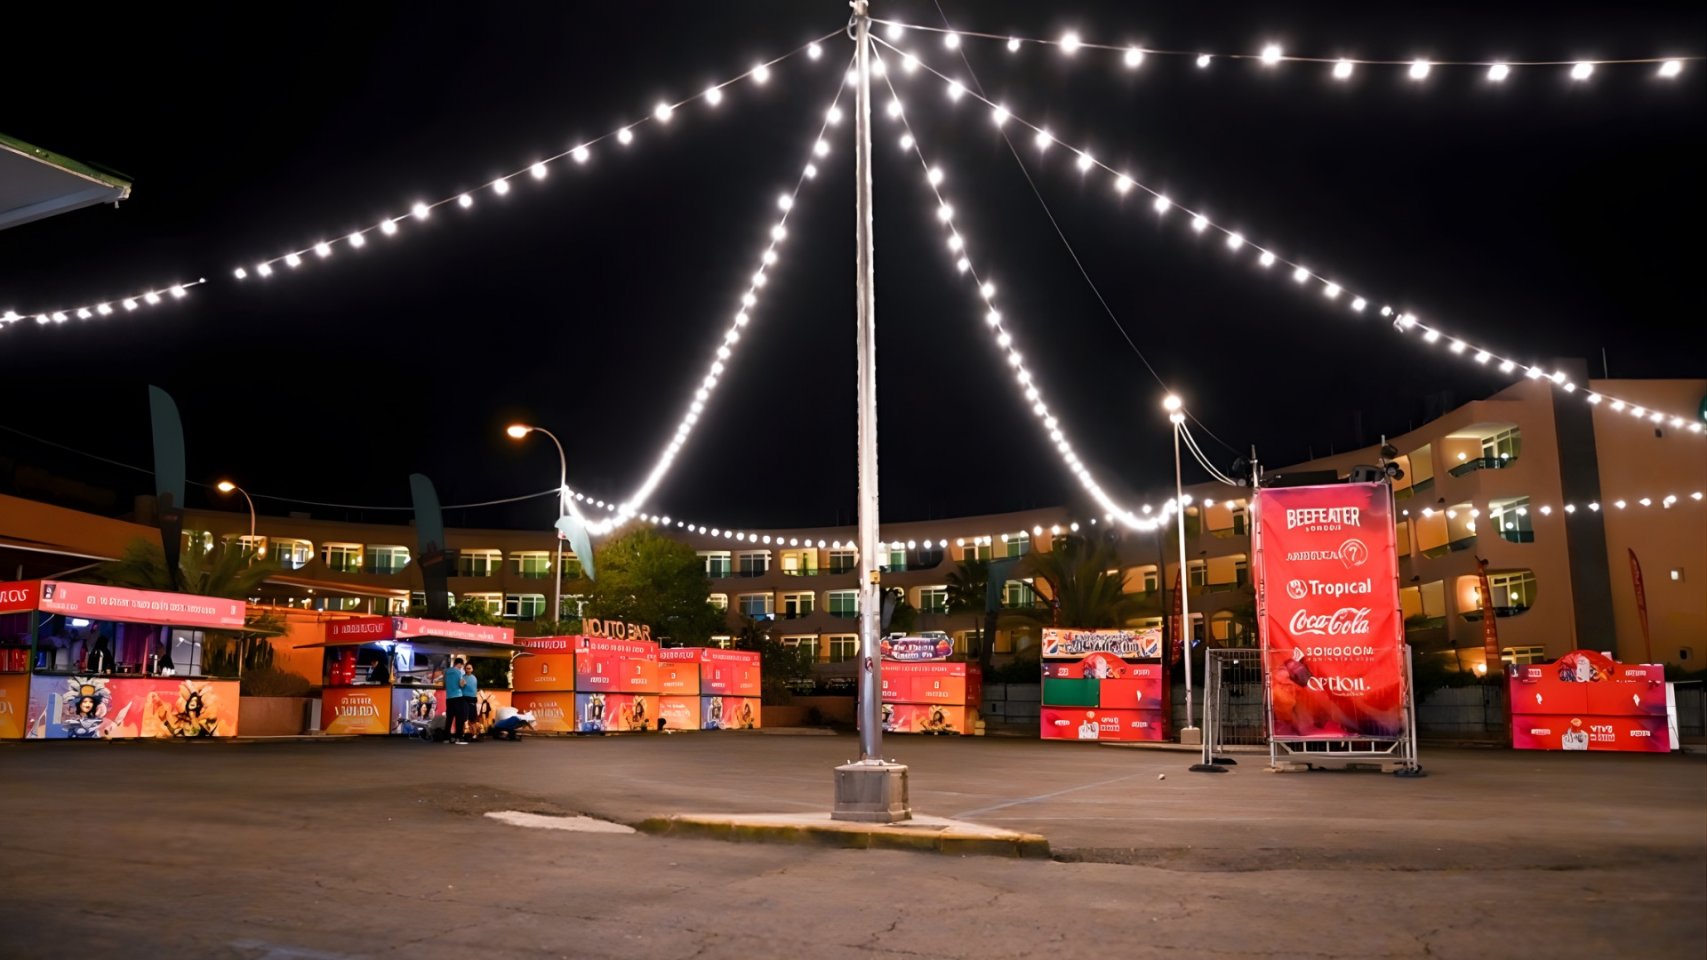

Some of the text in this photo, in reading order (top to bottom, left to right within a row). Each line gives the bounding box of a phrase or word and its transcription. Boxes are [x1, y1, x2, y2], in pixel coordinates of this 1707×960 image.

[1286, 506, 1361, 530] BEEFEATER
[1308, 577, 1372, 598] Tropical
[582, 617, 651, 642] MOJITO BAR
[1289, 607, 1372, 636] Coca-Cola
